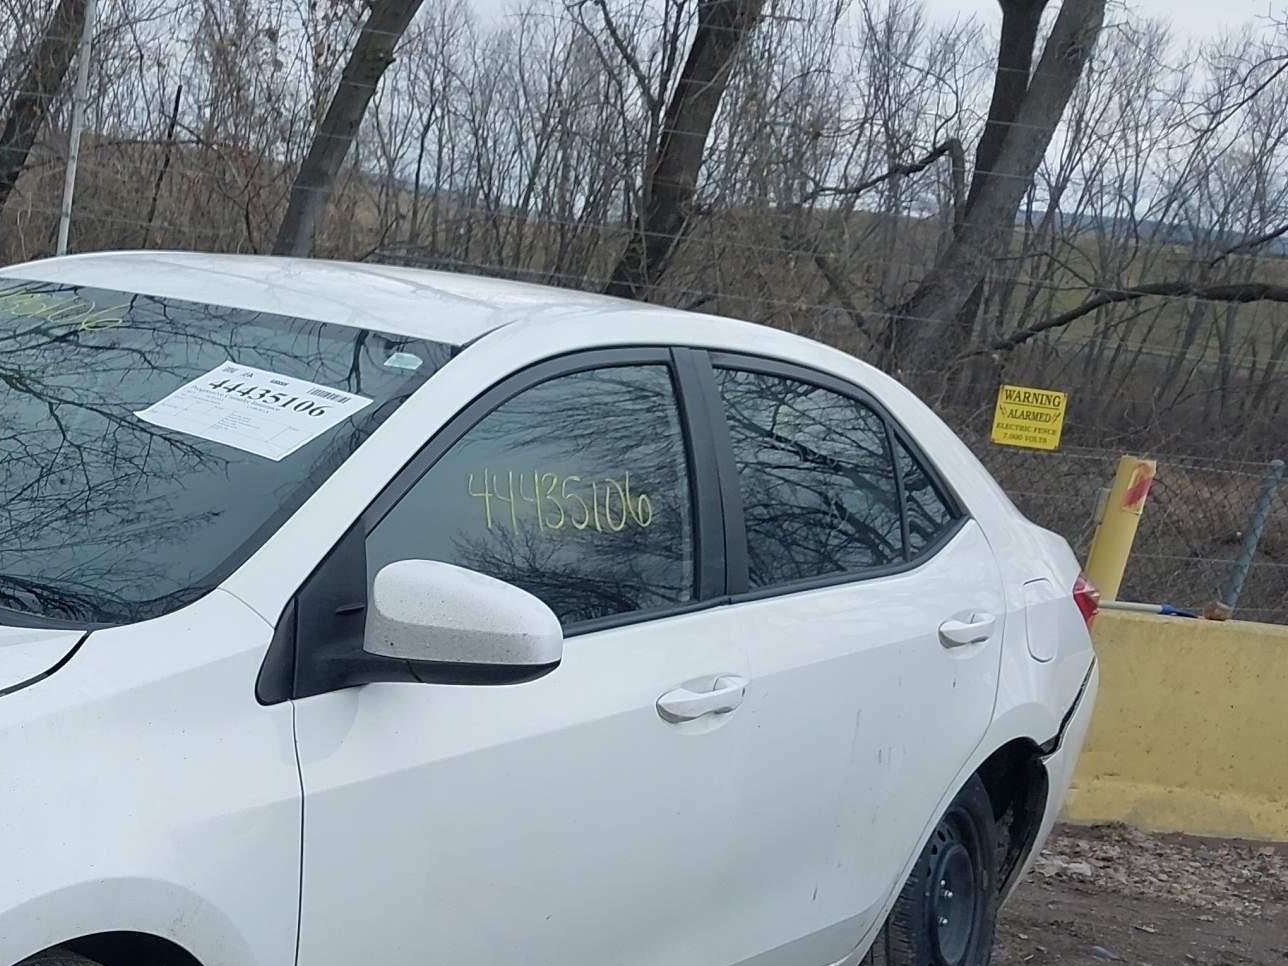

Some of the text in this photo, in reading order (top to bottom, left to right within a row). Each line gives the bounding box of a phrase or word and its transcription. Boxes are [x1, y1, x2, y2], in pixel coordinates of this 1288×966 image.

[209, 379, 328, 417] 44435106
[1004, 389, 1061, 407] WARNING
[1008, 408, 1051, 423] ALARMED
[996, 423, 1032, 432] ELECTRIC
[468, 468, 652, 535] 44435106
